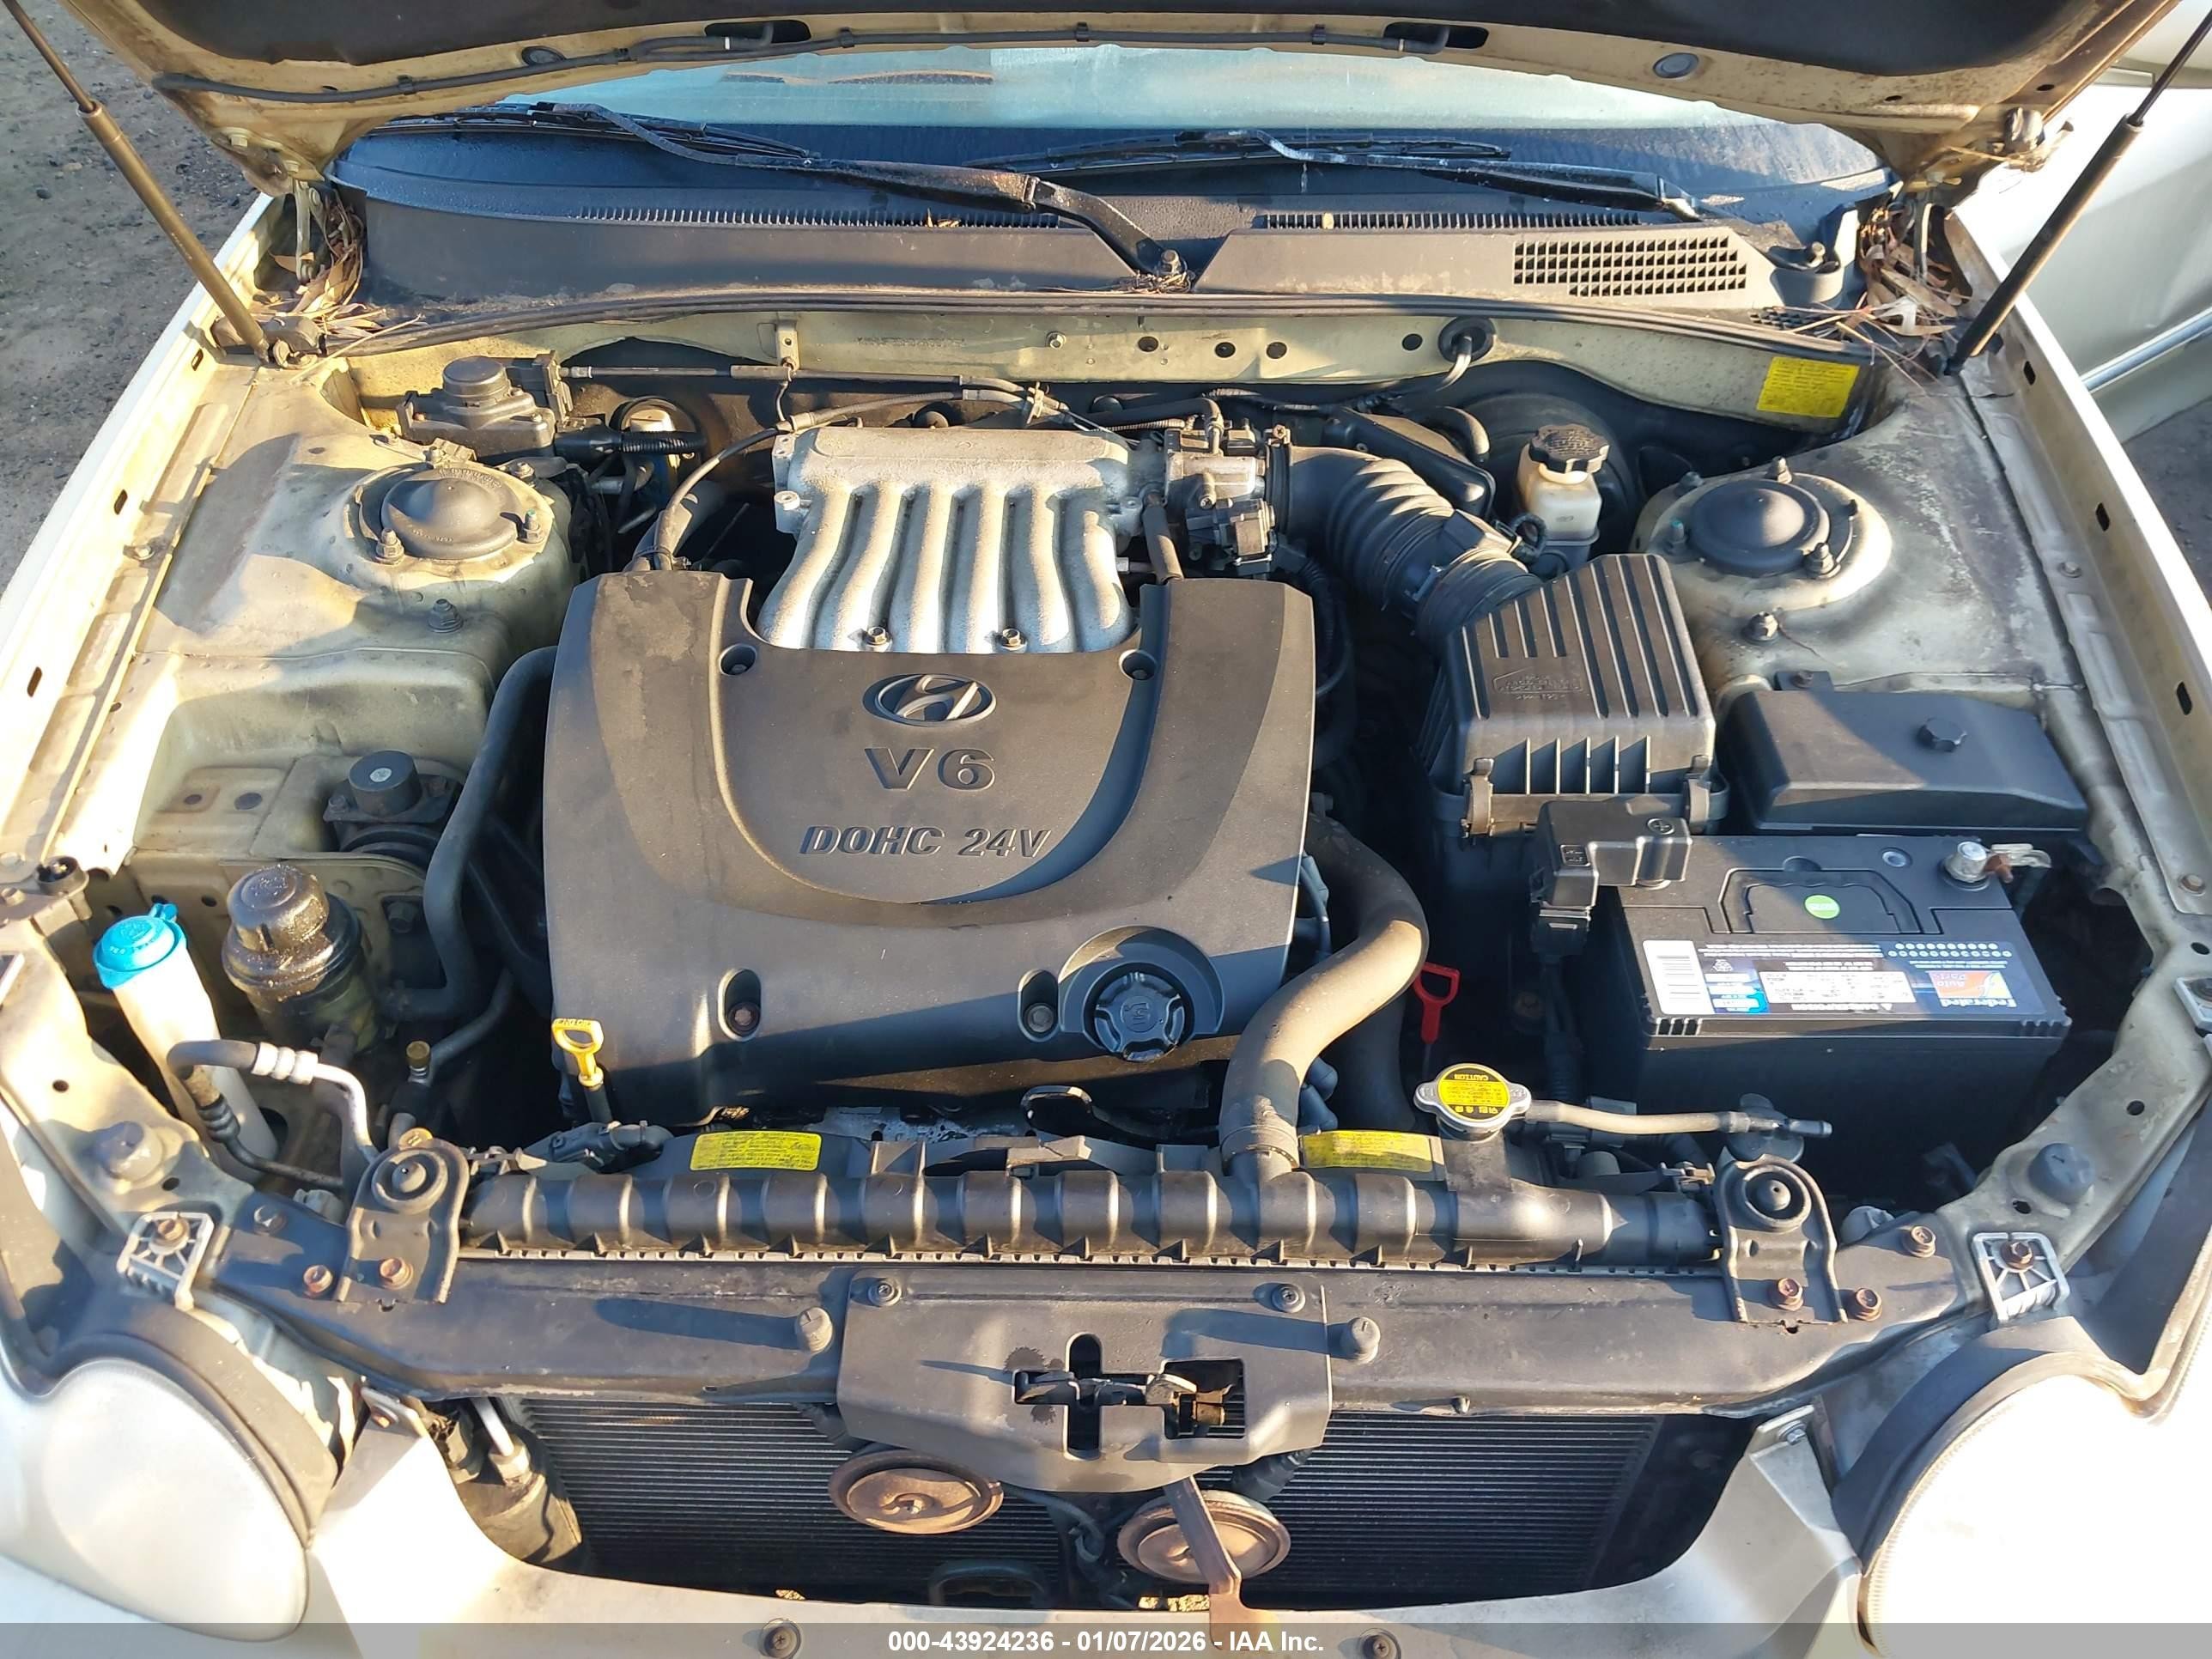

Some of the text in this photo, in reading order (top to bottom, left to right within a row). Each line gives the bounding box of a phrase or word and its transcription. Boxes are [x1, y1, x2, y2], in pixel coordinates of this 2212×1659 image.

[864, 747, 995, 791] V6
[799, 825, 1052, 858] DOHC 24V
[1936, 980, 1966, 988] Auto
[1940, 997, 2018, 1008] Federated
